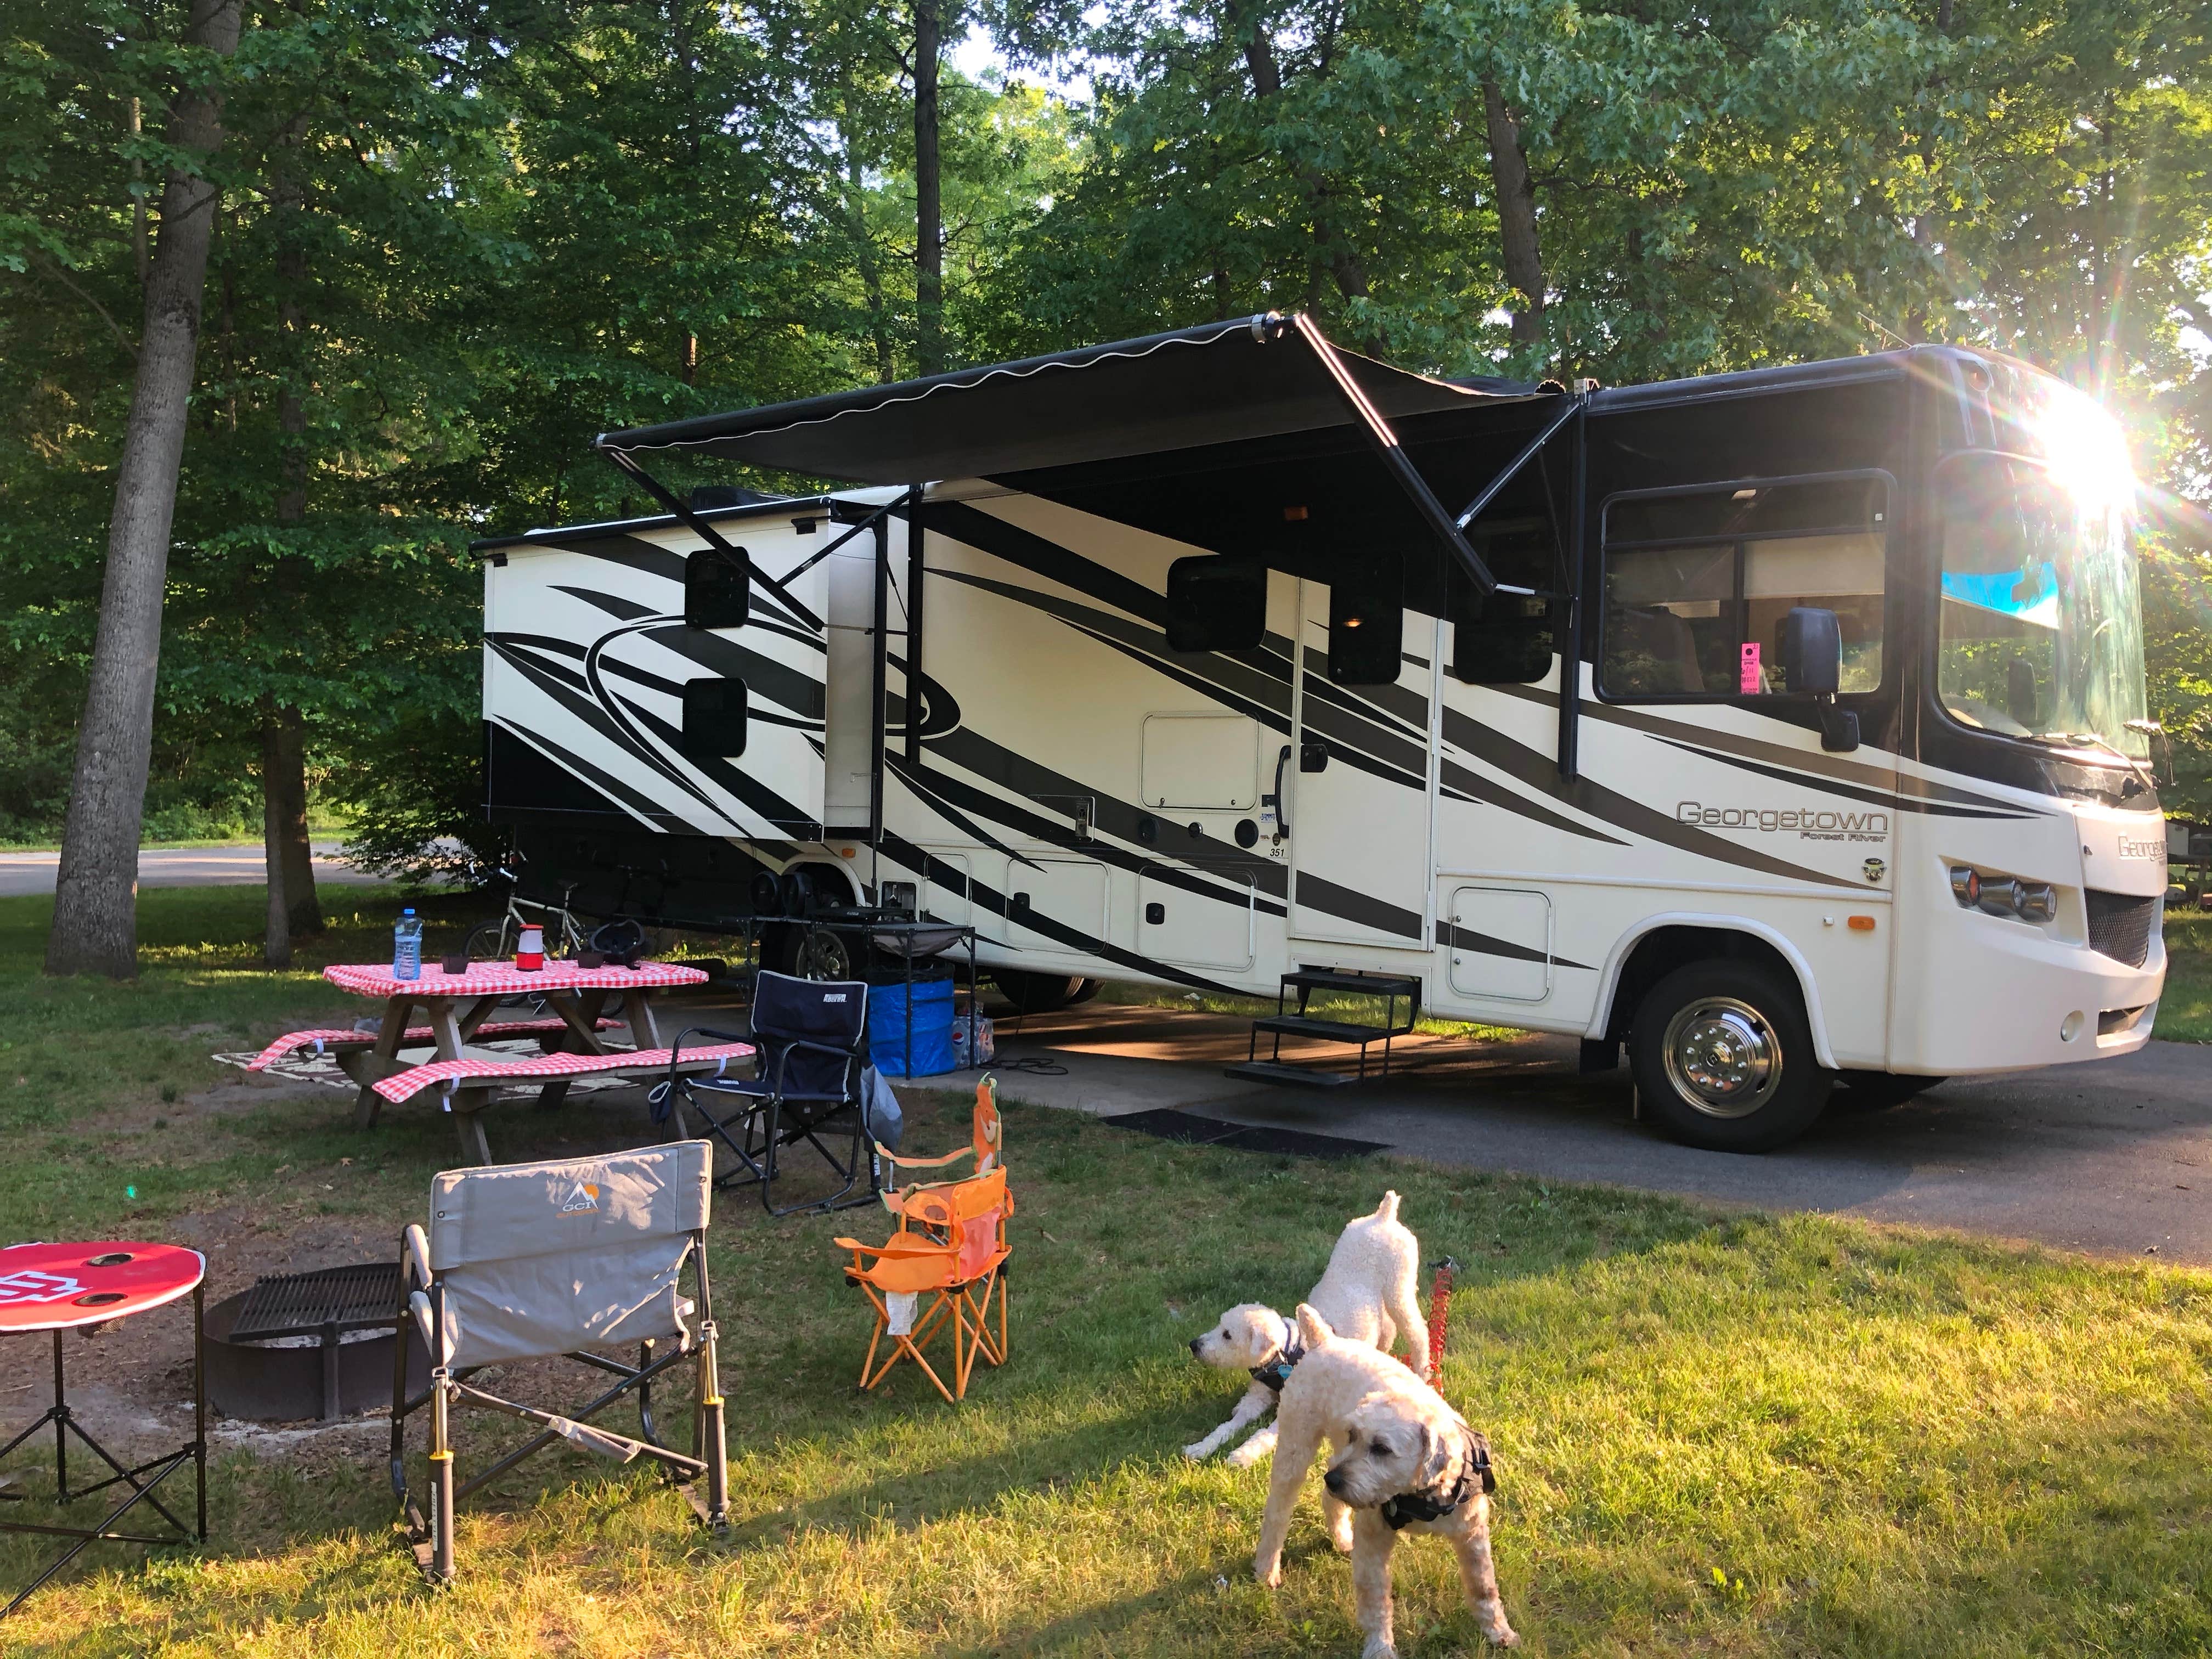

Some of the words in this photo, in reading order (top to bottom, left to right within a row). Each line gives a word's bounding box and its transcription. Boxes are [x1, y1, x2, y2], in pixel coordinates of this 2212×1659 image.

[1676, 801, 1888, 832] Georgetown
[1800, 832, 1844, 841] Forest
[1848, 833, 1886, 843] River
[1270, 848, 1284, 857] 351
[562, 1202, 591, 1212] GCI
